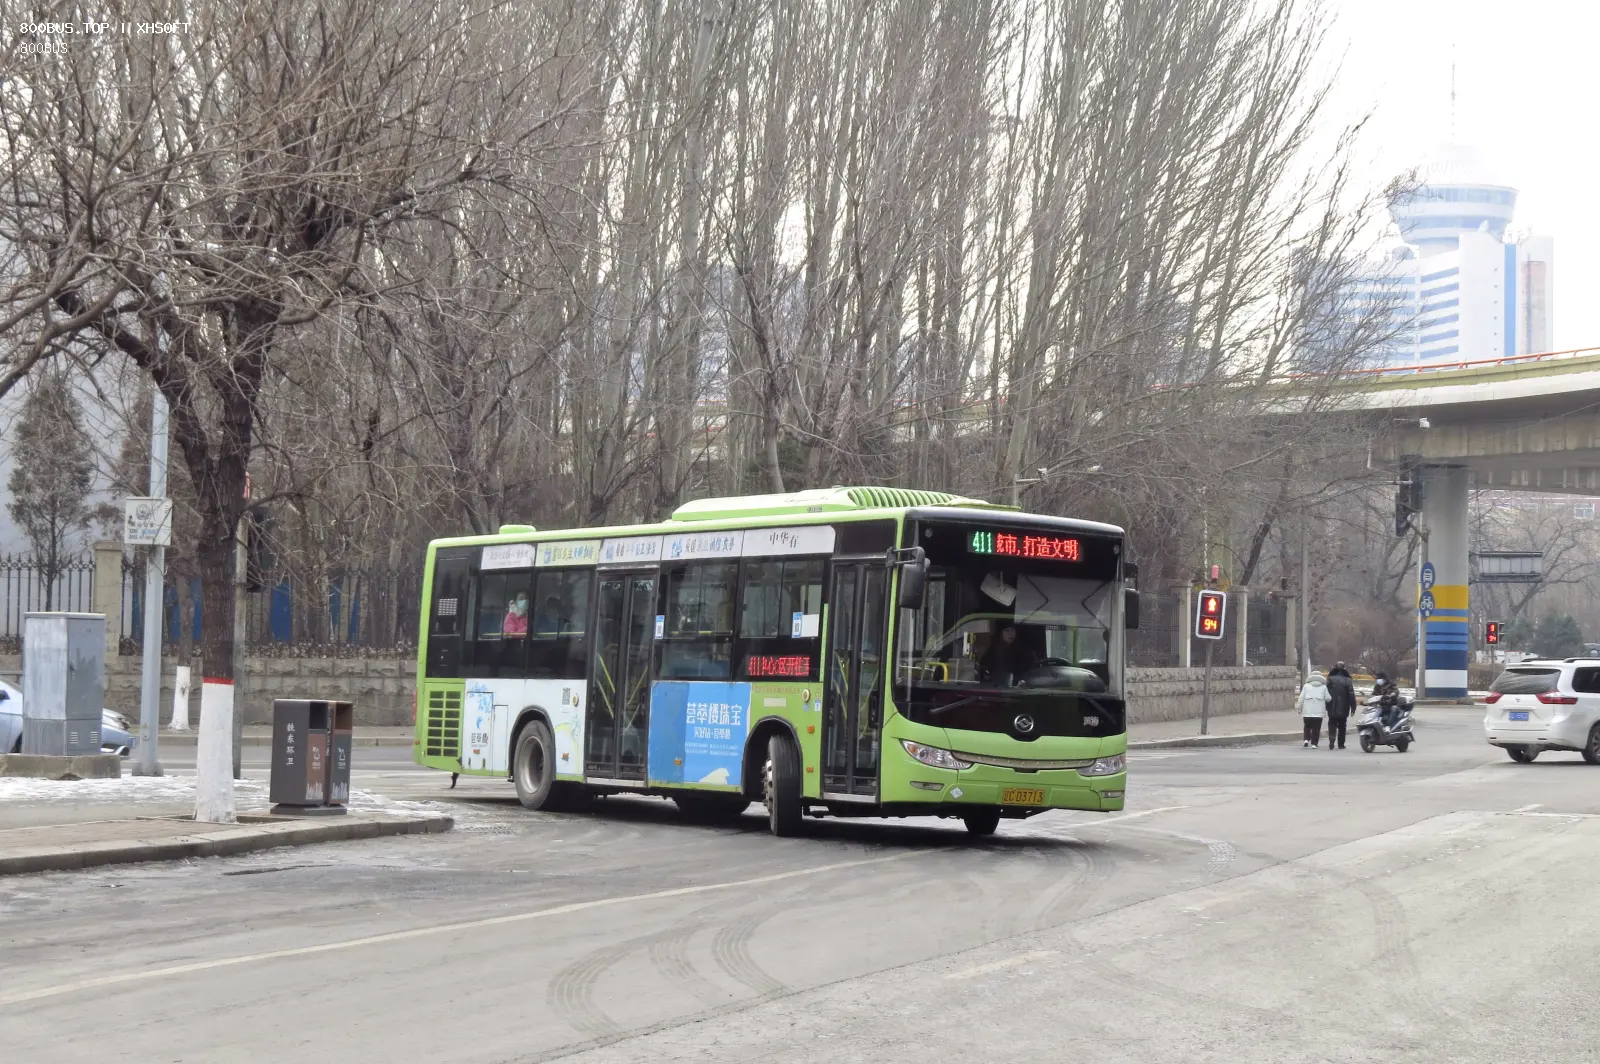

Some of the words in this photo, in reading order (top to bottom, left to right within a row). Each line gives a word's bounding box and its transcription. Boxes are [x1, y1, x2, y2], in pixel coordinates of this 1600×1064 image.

[972, 531, 992, 553] 411
[1204, 618, 1217, 630] 94
[285, 722, 296, 766] 铁东环卫
